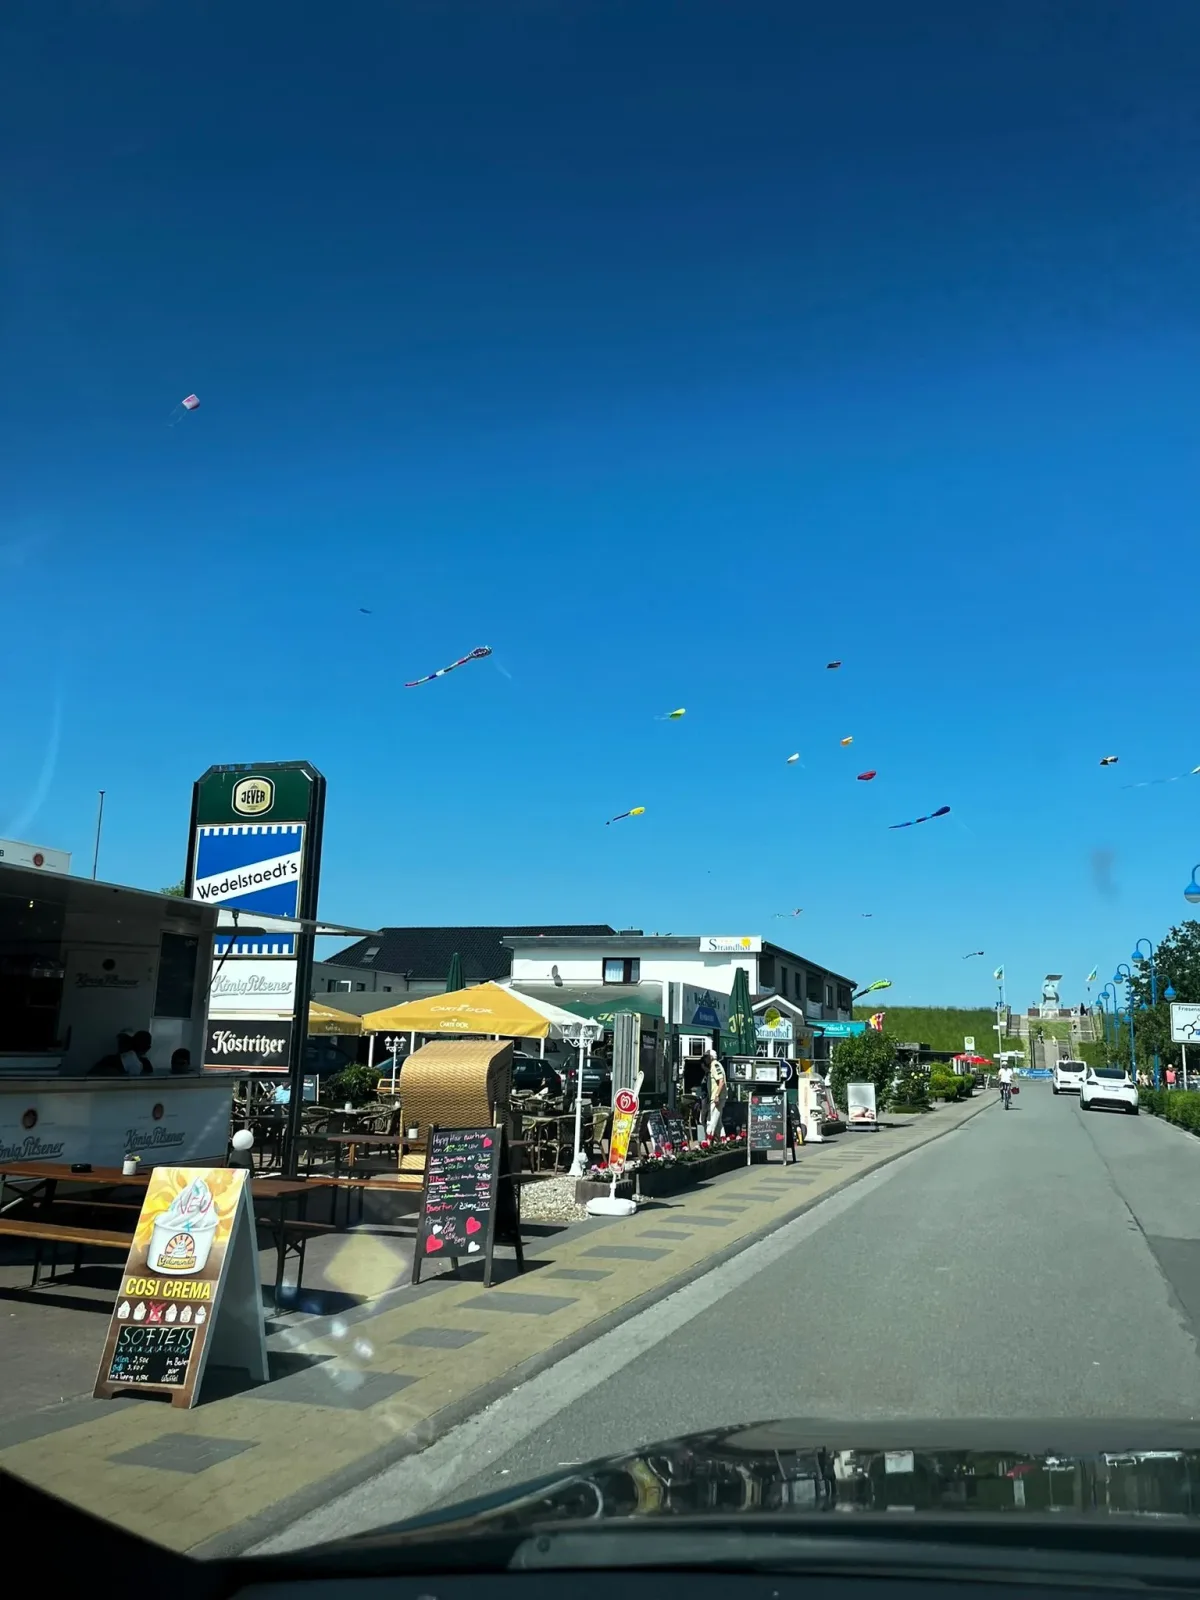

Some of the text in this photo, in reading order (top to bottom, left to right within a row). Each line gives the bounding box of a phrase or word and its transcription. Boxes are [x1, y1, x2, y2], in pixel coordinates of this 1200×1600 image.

[241, 789, 265, 805] JEVER
[212, 974, 293, 994] König Pilsener
[211, 1030, 286, 1057] Köstritzer
[0, 1135, 65, 1160] önig Pilsener
[124, 1126, 185, 1149] König Pilsener
[179, 1192, 214, 1215] NEU
[125, 1278, 211, 1299] COSI CREMA
[118, 1327, 194, 1348] SOFTEIS
